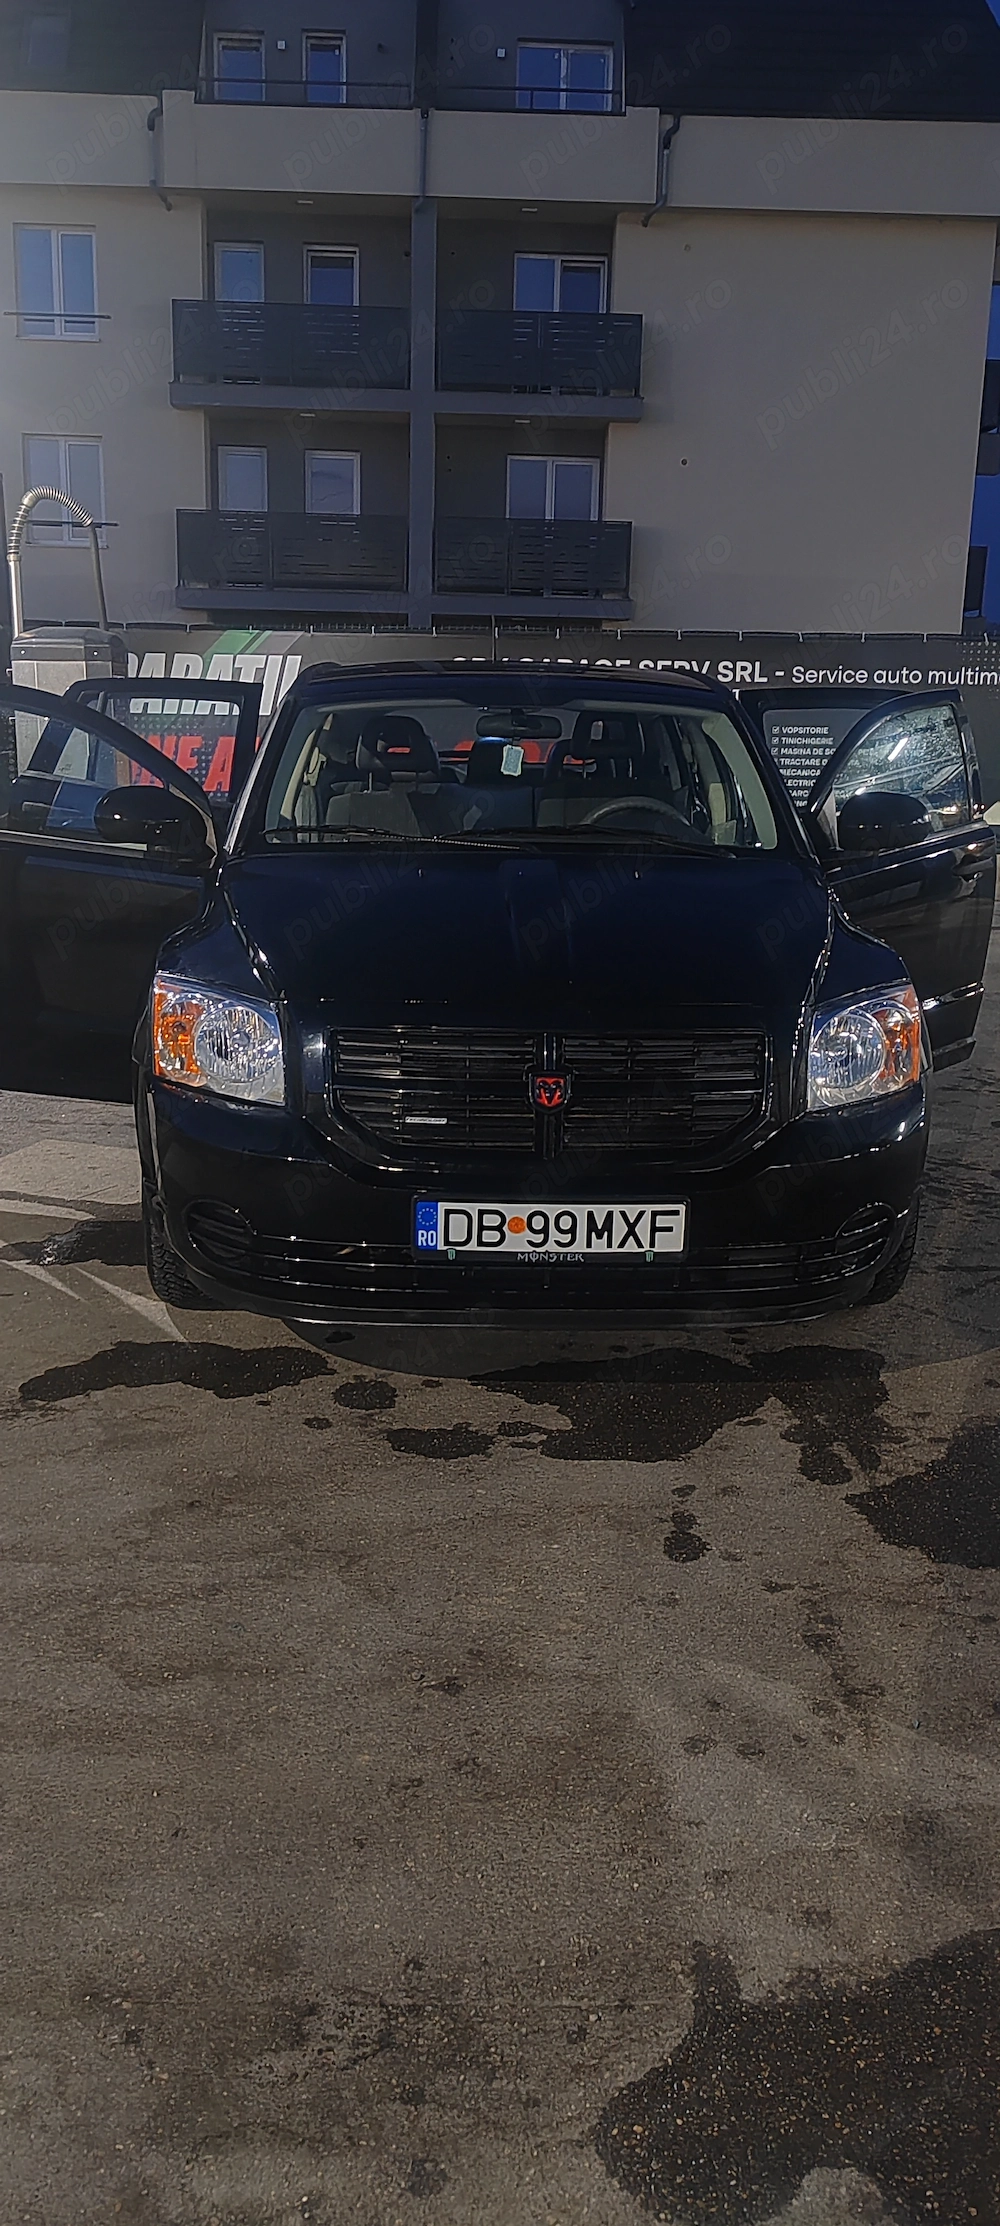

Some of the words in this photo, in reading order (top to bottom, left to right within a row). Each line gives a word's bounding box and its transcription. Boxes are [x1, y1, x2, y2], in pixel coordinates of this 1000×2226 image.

[717, 660, 768, 683] SRL
[791, 665, 869, 684] Service
[873, 666, 922, 685] auto
[928, 666, 1000, 686] multim
[781, 726, 829, 734] VOPSITORIE
[780, 737, 833, 745] TINICHIGERIE
[780, 747, 812, 755] MASINA
[779, 758, 821, 766] TRACTARE
[417, 1229, 437, 1246] RO
[443, 1208, 507, 1248] DB
[526, 1210, 577, 1249] 99
[586, 1210, 681, 1249] MXF
